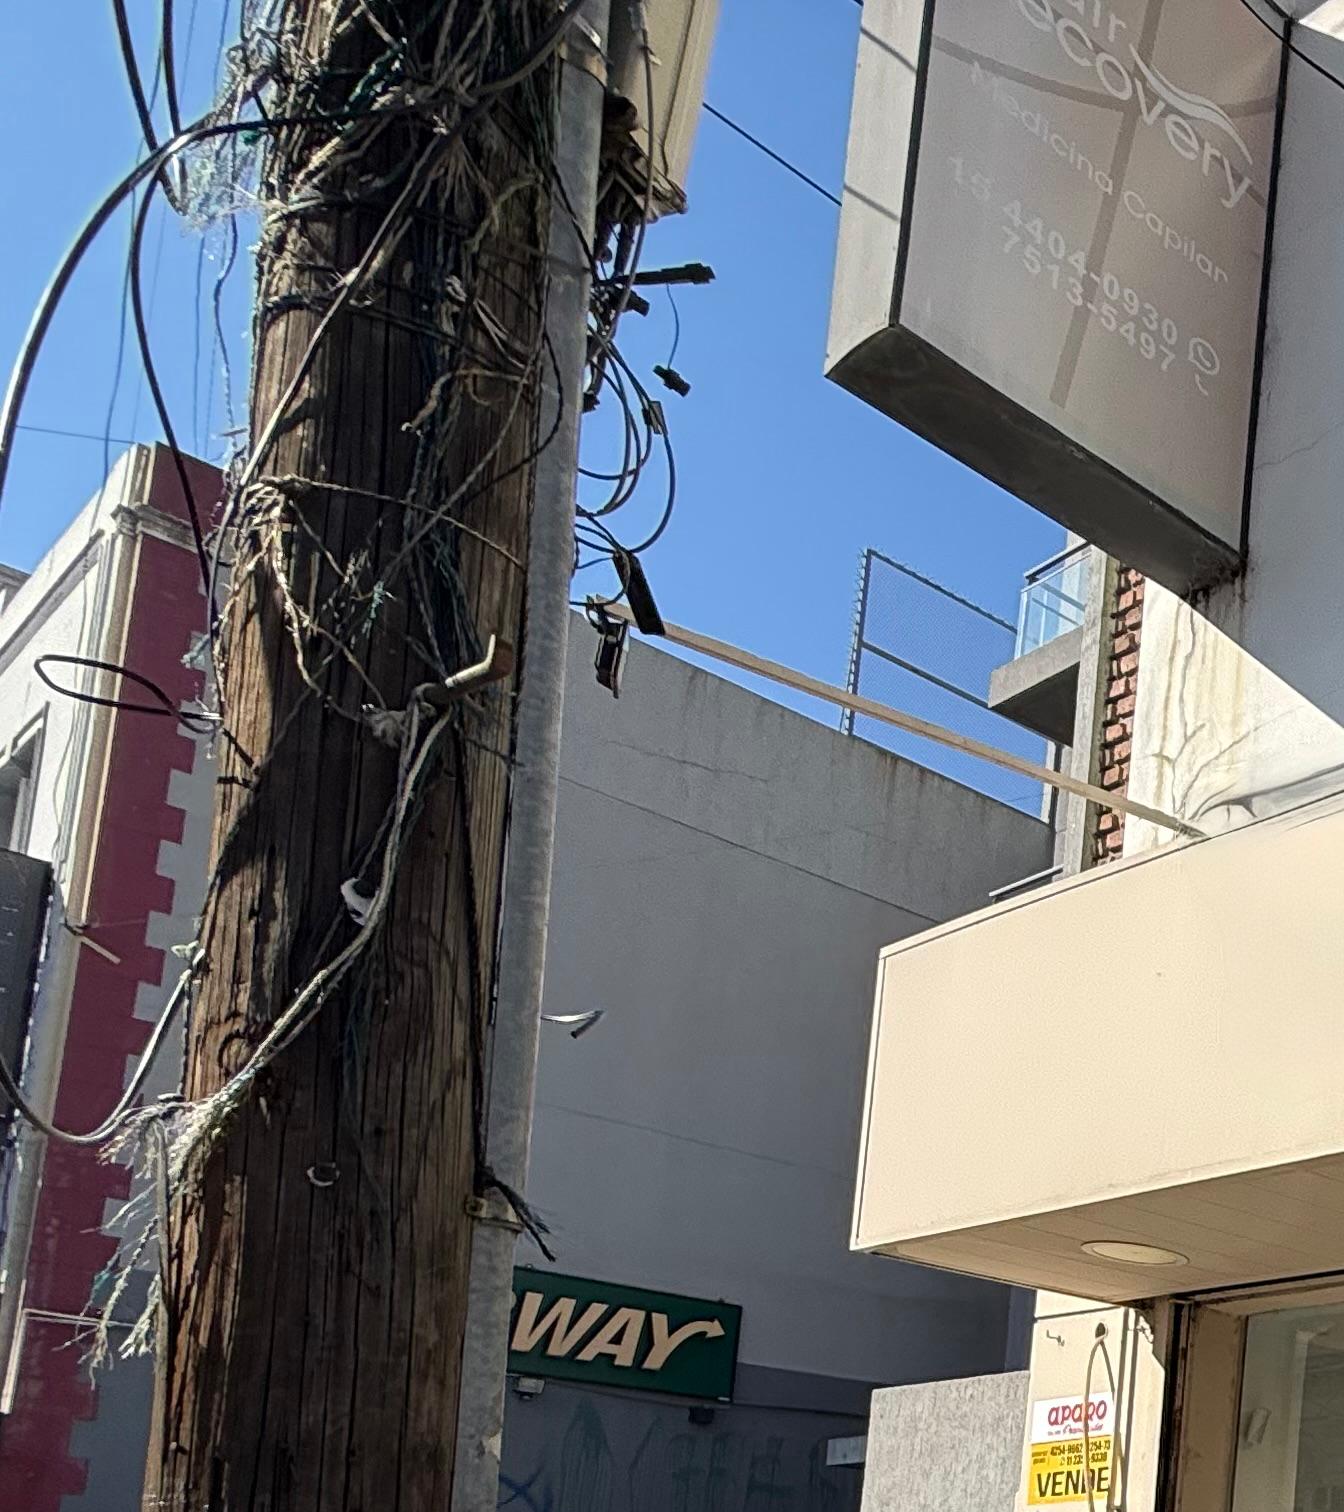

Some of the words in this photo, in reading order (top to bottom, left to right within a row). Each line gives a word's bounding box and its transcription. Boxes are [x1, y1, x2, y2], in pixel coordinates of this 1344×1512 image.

[1002, 200, 1178, 346] 4404-0930
[1123, 190, 1229, 283] Capilar
[1001, 225, 1176, 371] 7513-5497
[510, 1290, 725, 1371] WAY
[1036, 1466, 1110, 1498] VENDE
